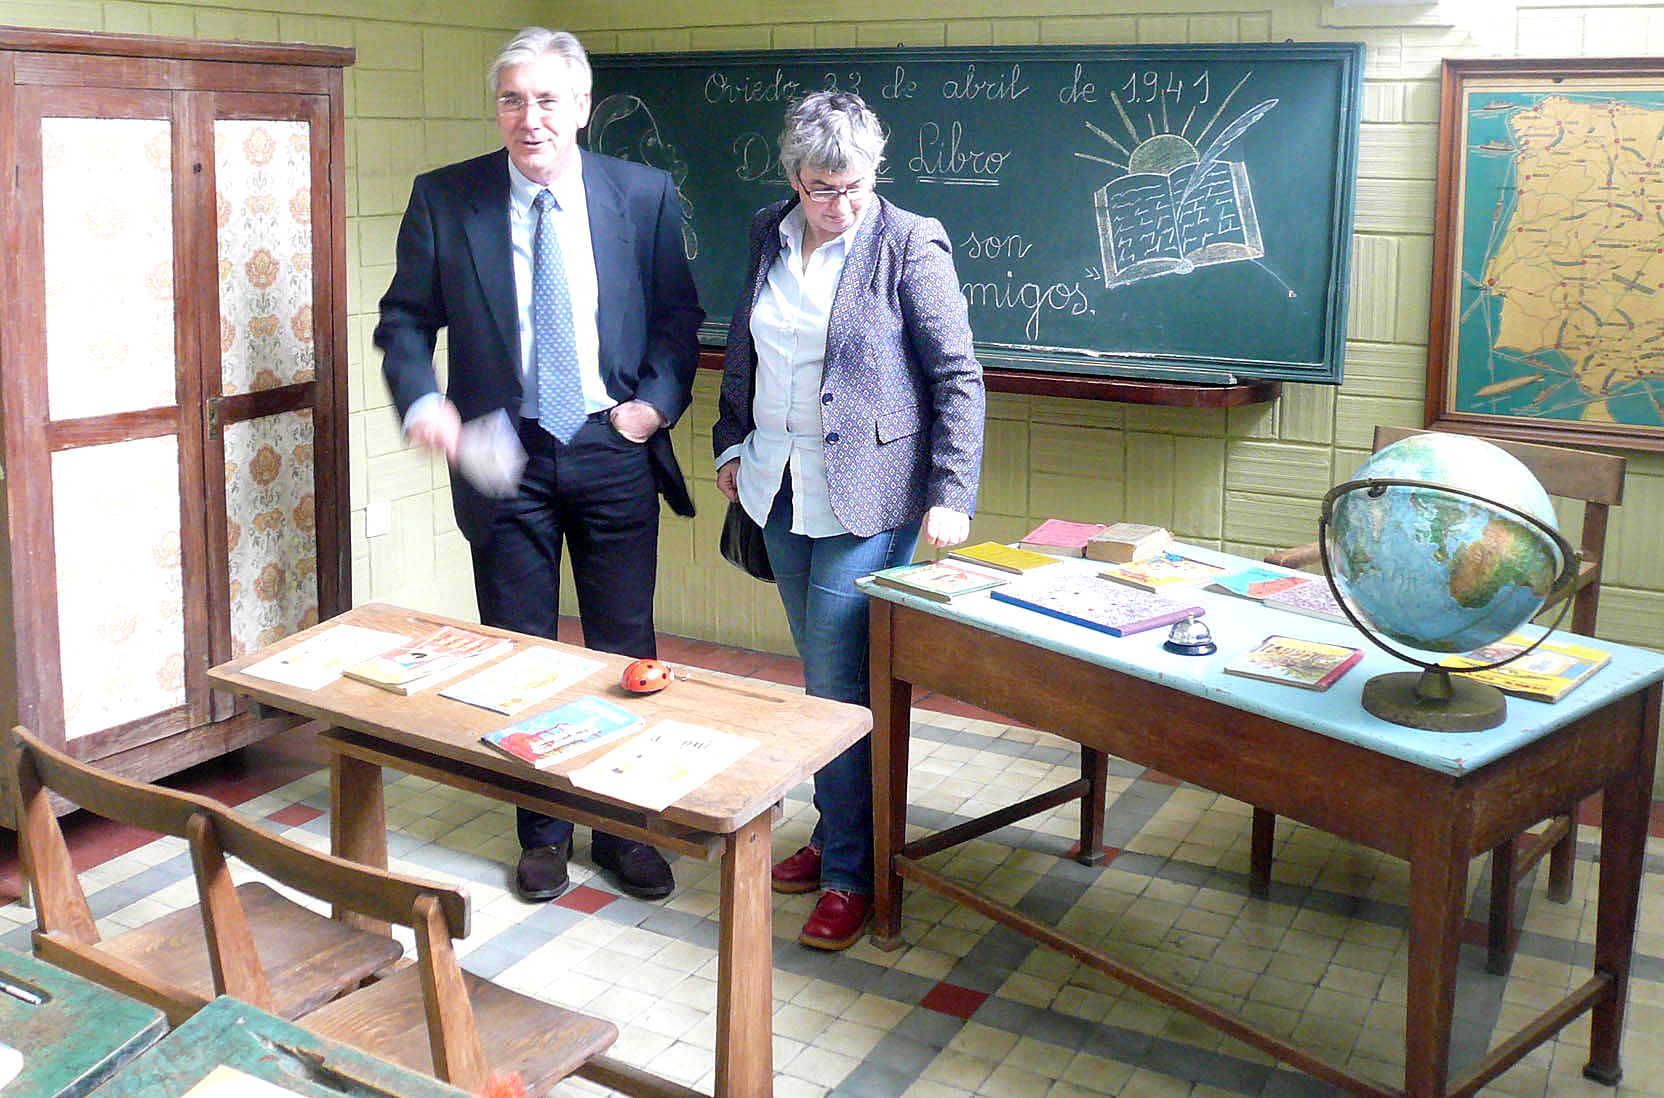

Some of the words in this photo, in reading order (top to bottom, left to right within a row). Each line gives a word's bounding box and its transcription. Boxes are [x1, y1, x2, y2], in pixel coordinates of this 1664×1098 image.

[704, 68, 800, 103] Oviedo
[881, 65, 917, 99] de
[942, 63, 1030, 100] abril
[1059, 63, 1097, 103] de
[908, 120, 1013, 175] Libro
[959, 231, 1033, 259] son
